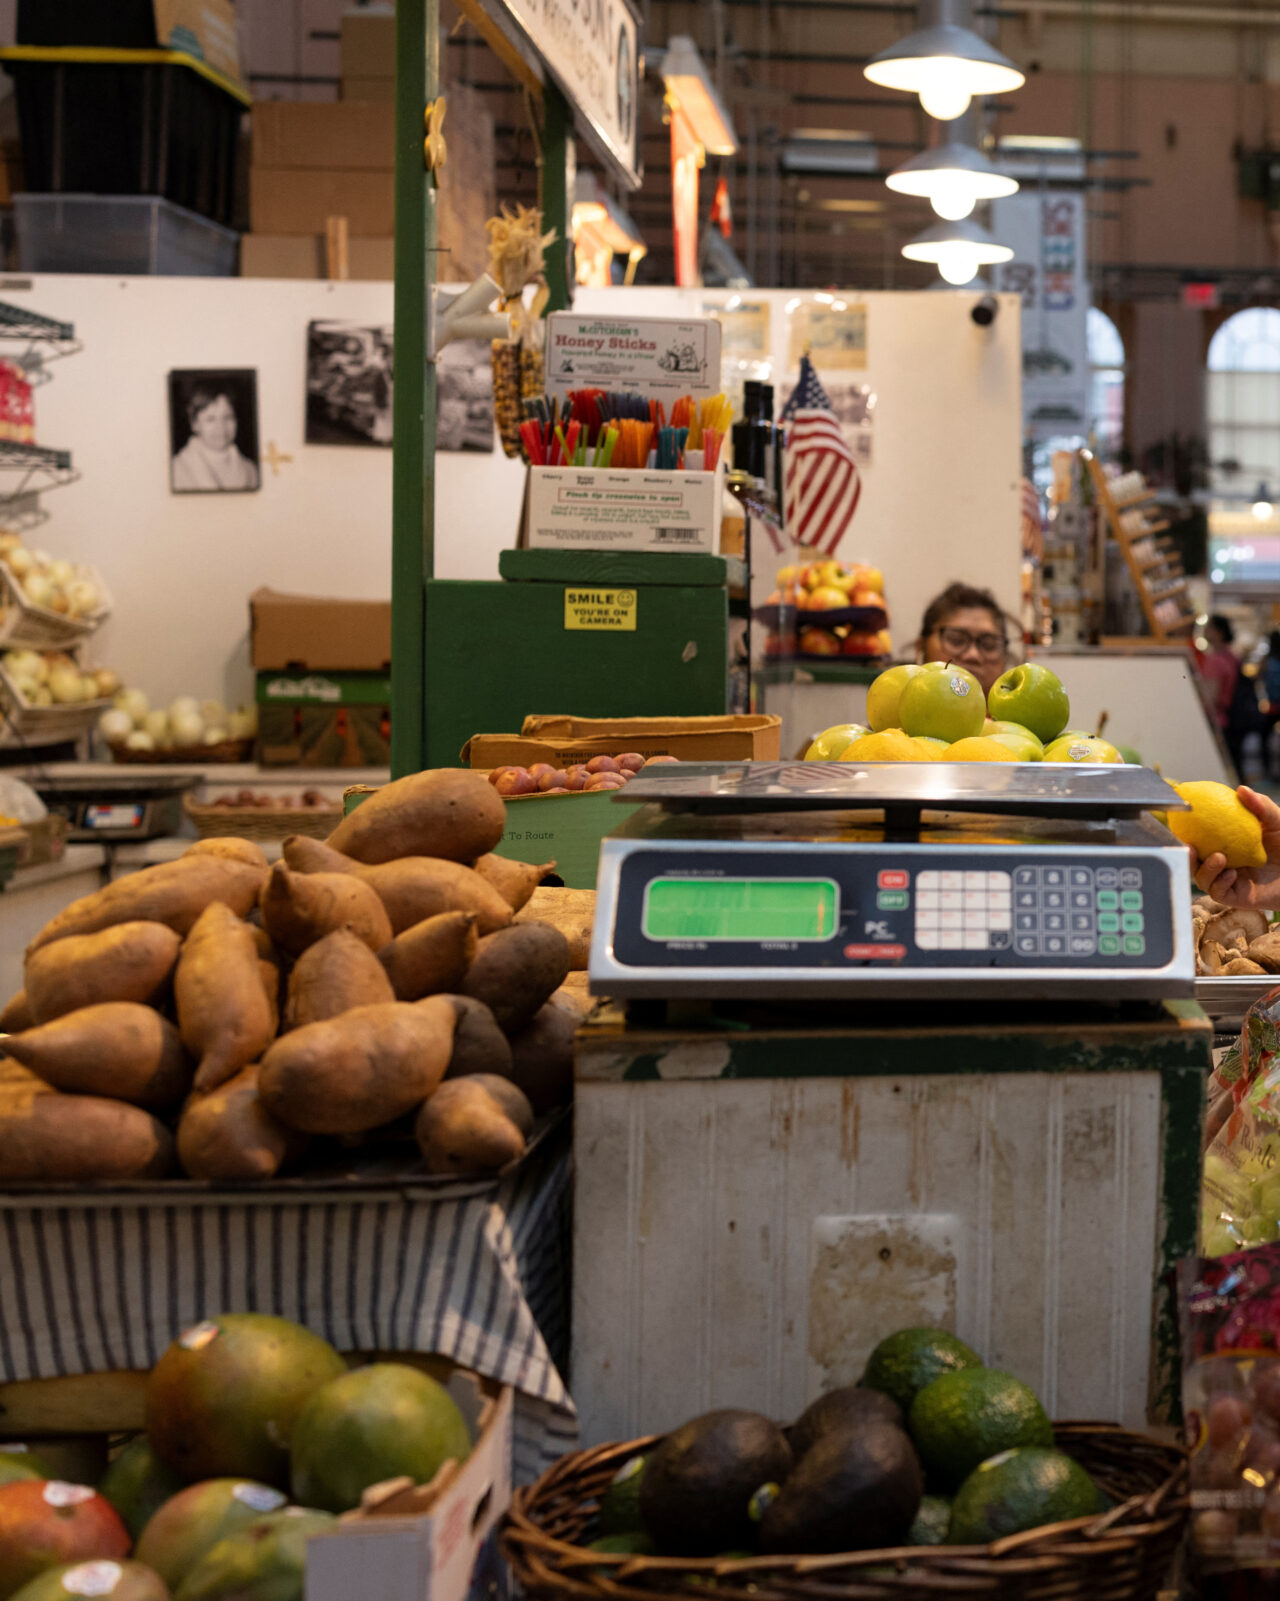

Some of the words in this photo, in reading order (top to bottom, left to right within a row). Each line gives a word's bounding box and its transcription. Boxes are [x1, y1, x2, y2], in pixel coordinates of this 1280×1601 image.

[555, 335, 605, 351] Honey
[608, 337, 657, 351] Sticks
[592, 492, 602, 500] tip
[605, 493, 646, 501] crosswise
[568, 592, 615, 605] SMILE
[574, 607, 610, 617] YOU'RE
[613, 609, 629, 617] ON
[579, 617, 622, 625] CAMERA
[509, 831, 522, 840] To
[525, 831, 555, 840] Route
[884, 876, 903, 884] ON
[1020, 872, 1032, 883] 7
[1049, 872, 1059, 884] 8
[1075, 872, 1087, 884] 9
[1021, 894, 1033, 906] 4
[1049, 894, 1060, 906] 5
[1076, 894, 1088, 906] 6
[1022, 916, 1032, 928] 1
[1050, 916, 1061, 928] 2
[1077, 916, 1088, 928] 3
[865, 920, 889, 936] PC
[1021, 939, 1034, 950] C
[1050, 939, 1061, 950] 0
